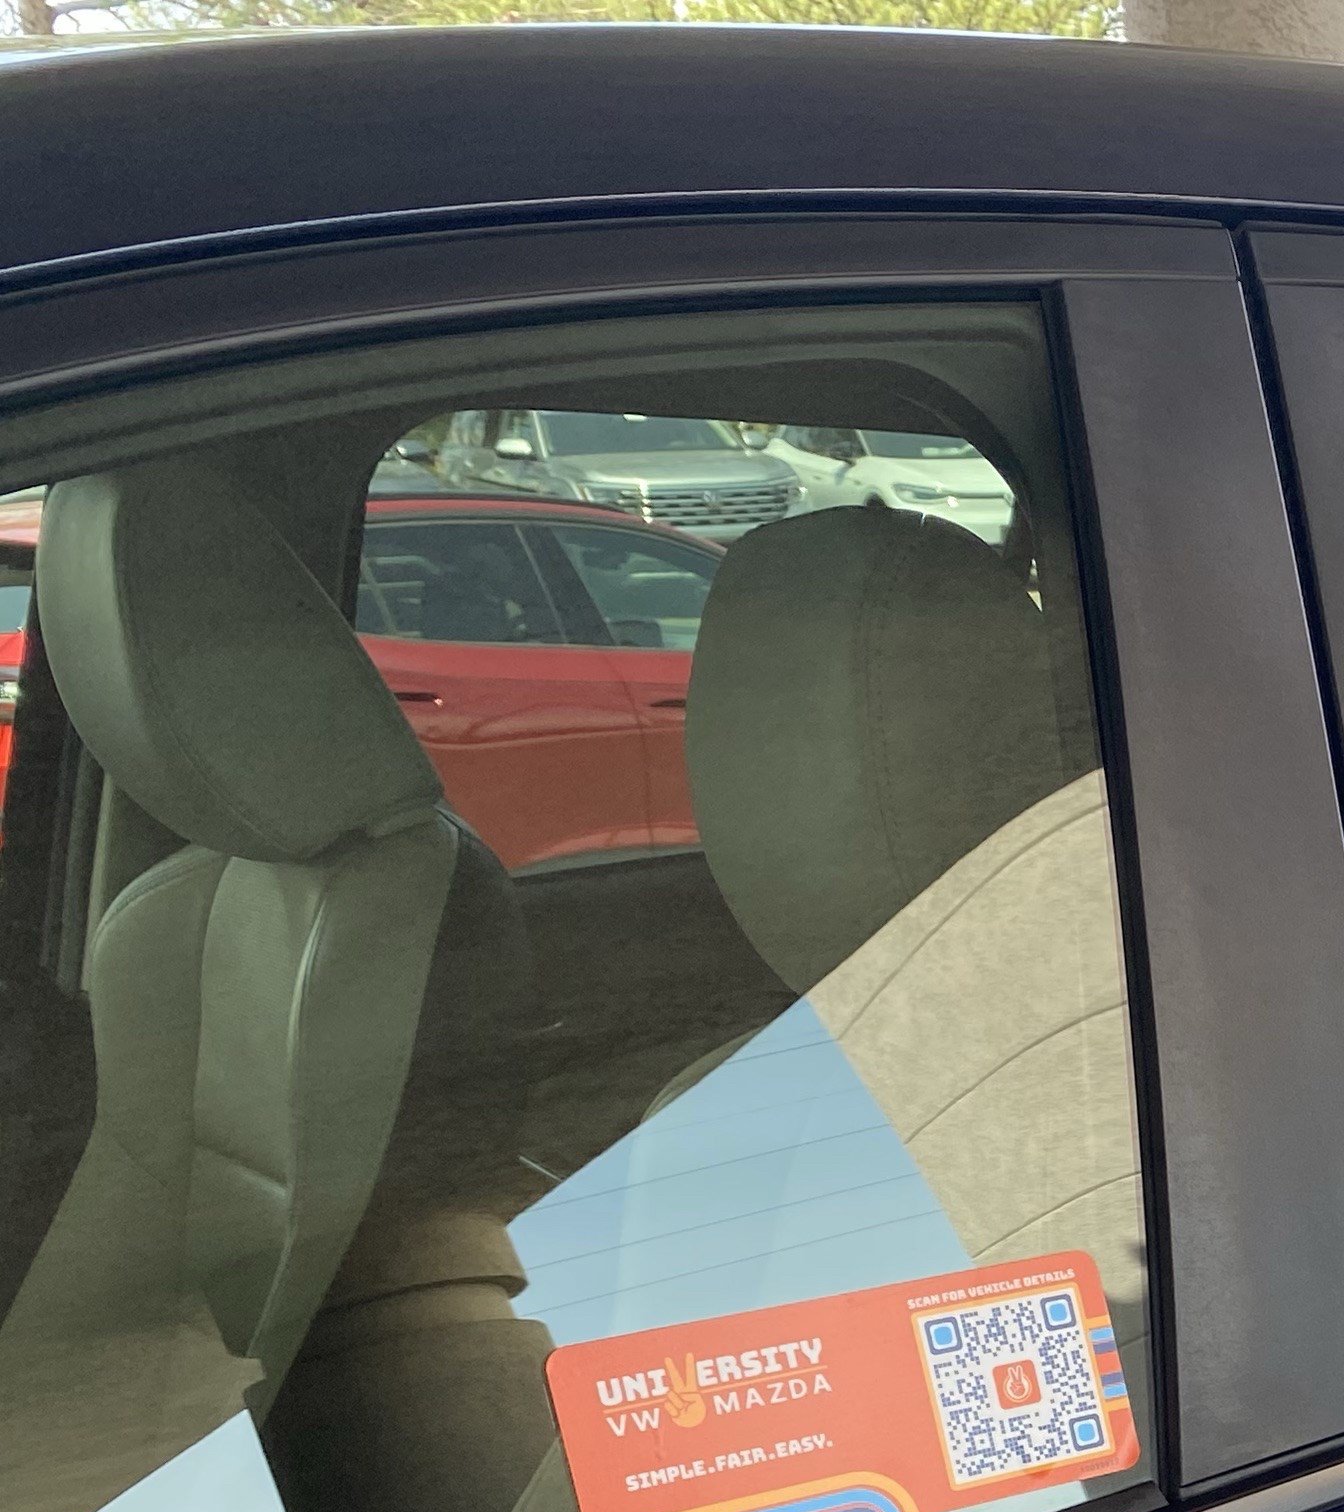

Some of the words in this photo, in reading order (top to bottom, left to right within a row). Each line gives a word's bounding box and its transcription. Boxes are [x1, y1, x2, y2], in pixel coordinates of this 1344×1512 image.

[907, 1297, 940, 1310] SCAN
[941, 1290, 967, 1304] FOR
[967, 1278, 1022, 1298] VEHICLE
[1023, 1268, 1076, 1288] DETAILS
[596, 1338, 822, 1407] UNIVERSITY
[605, 1407, 660, 1437] VW
[713, 1374, 832, 1416] MAZDA
